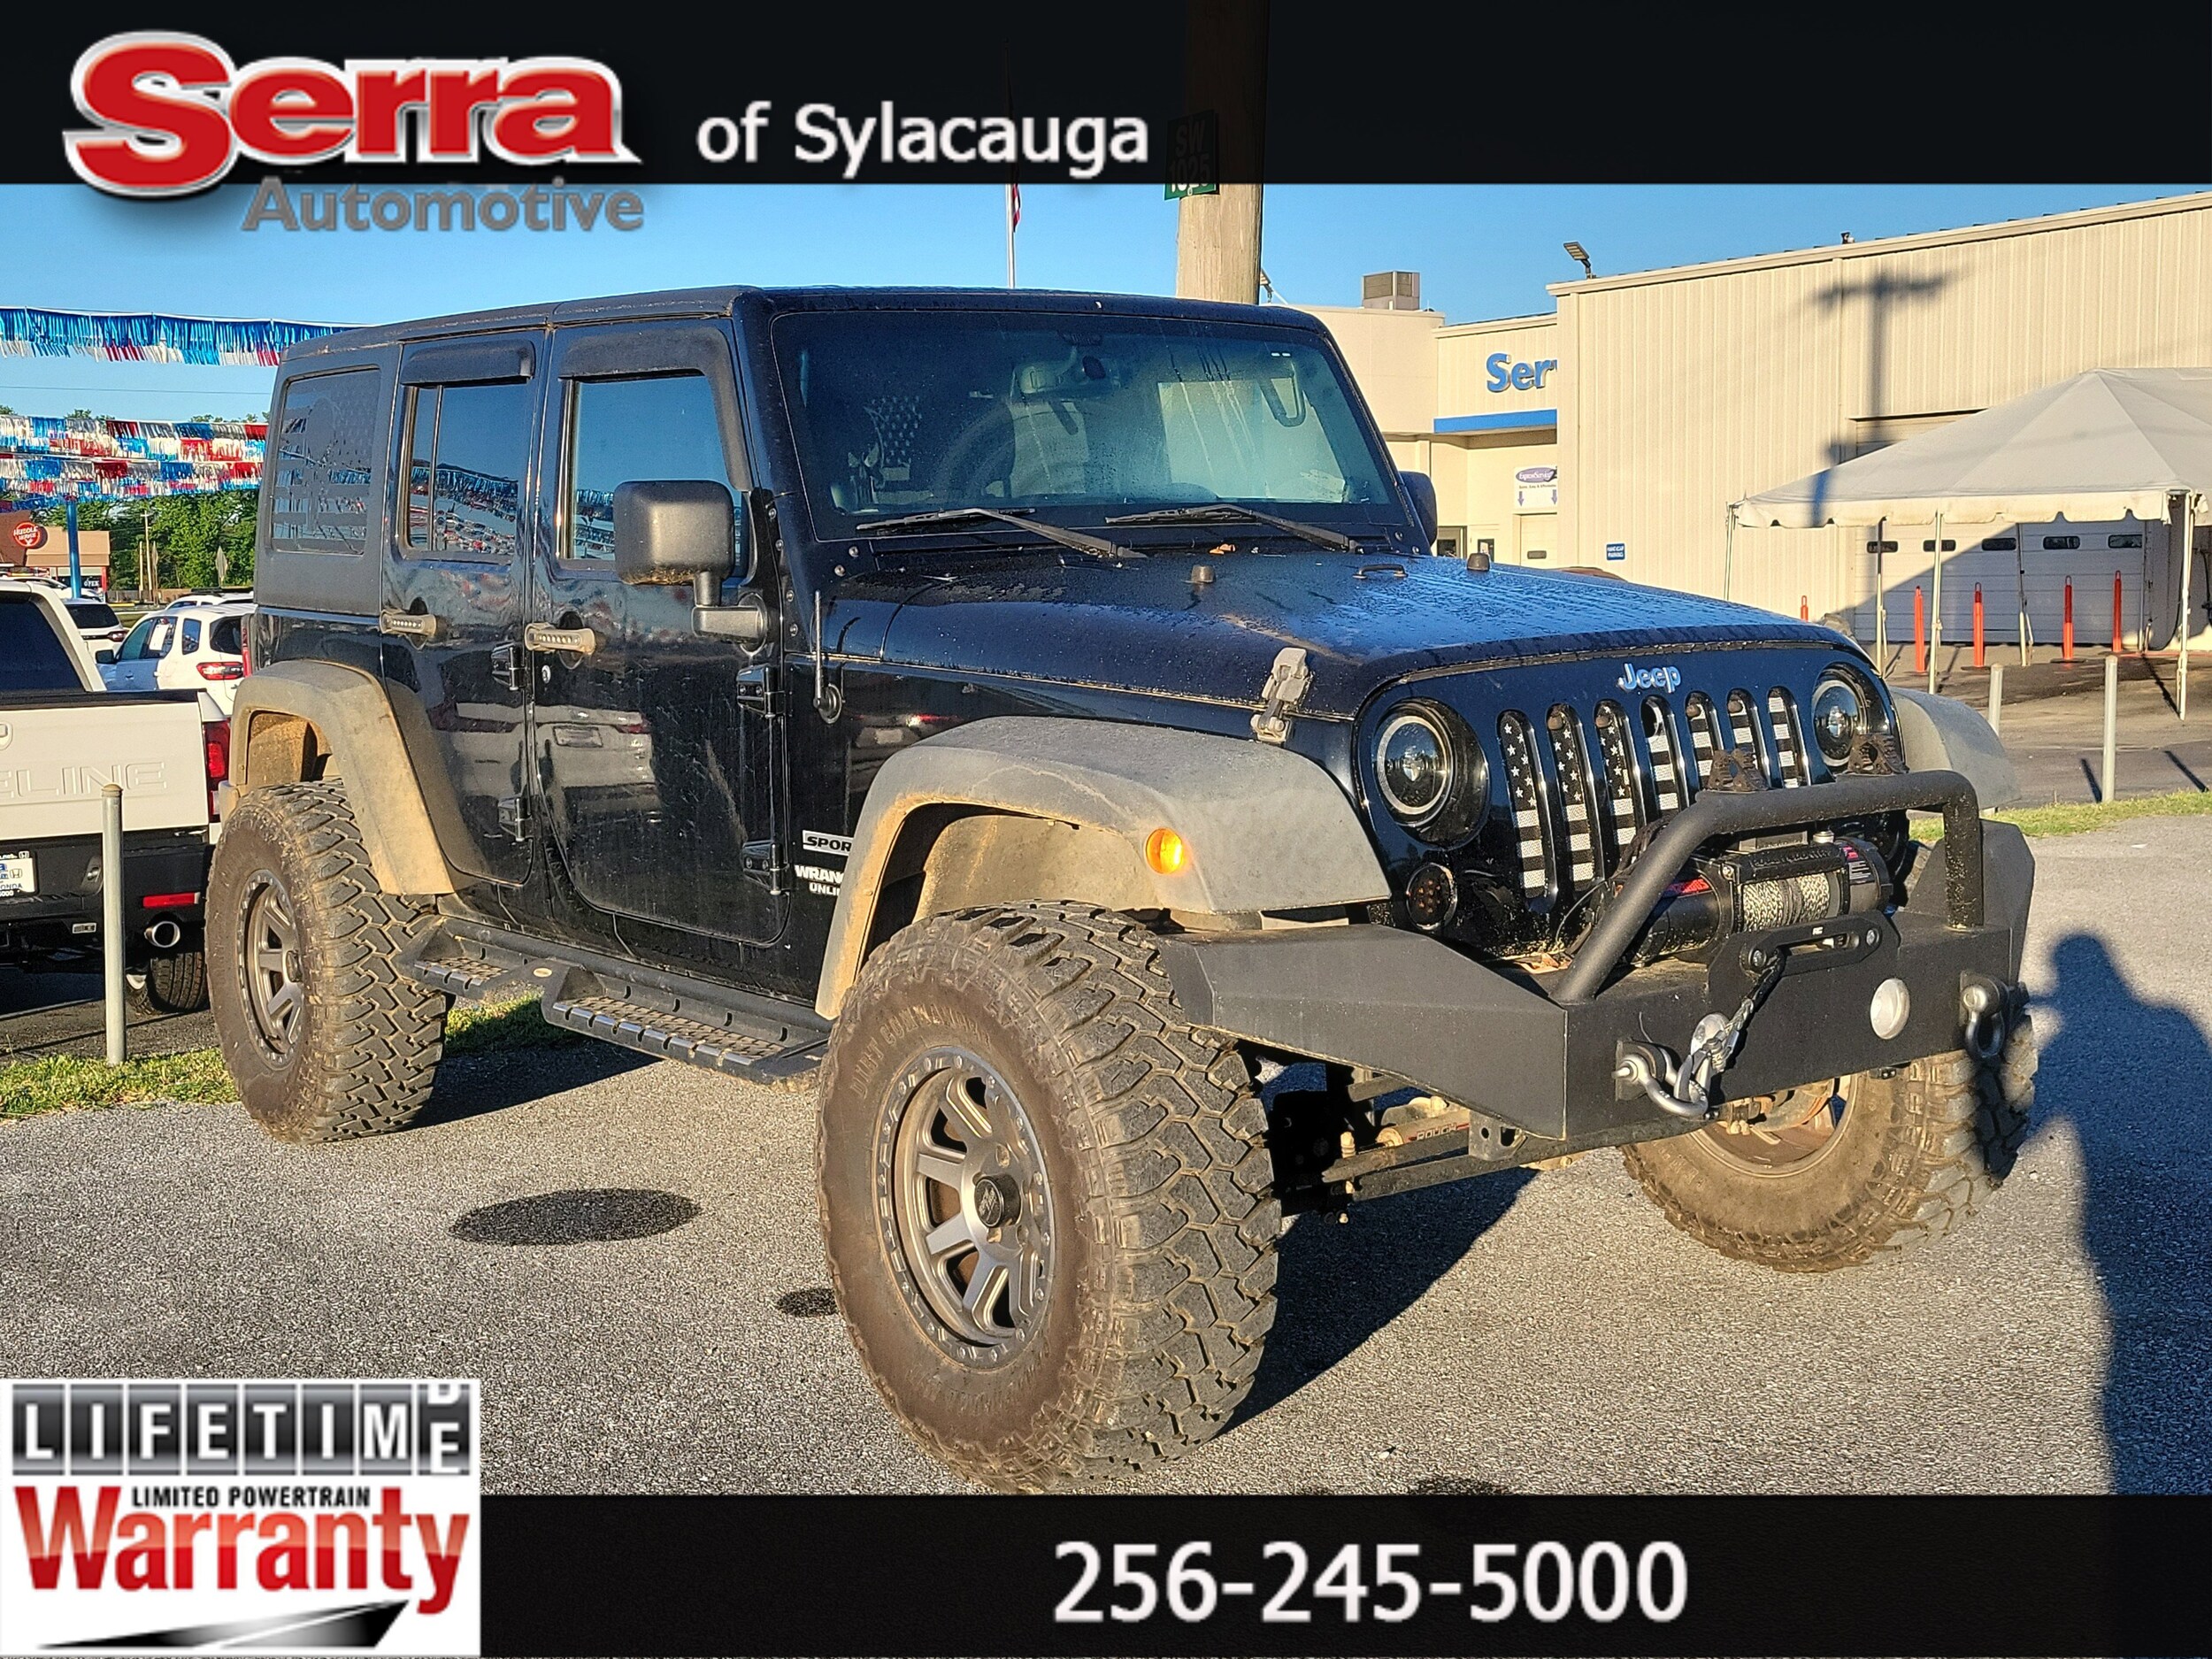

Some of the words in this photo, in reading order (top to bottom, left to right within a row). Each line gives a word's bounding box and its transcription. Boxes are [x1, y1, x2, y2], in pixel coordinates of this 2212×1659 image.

[1486, 352, 1557, 392] Ser
[1616, 663, 1681, 694] Jeep
[1417, 1123, 1457, 1141] ROUGH
